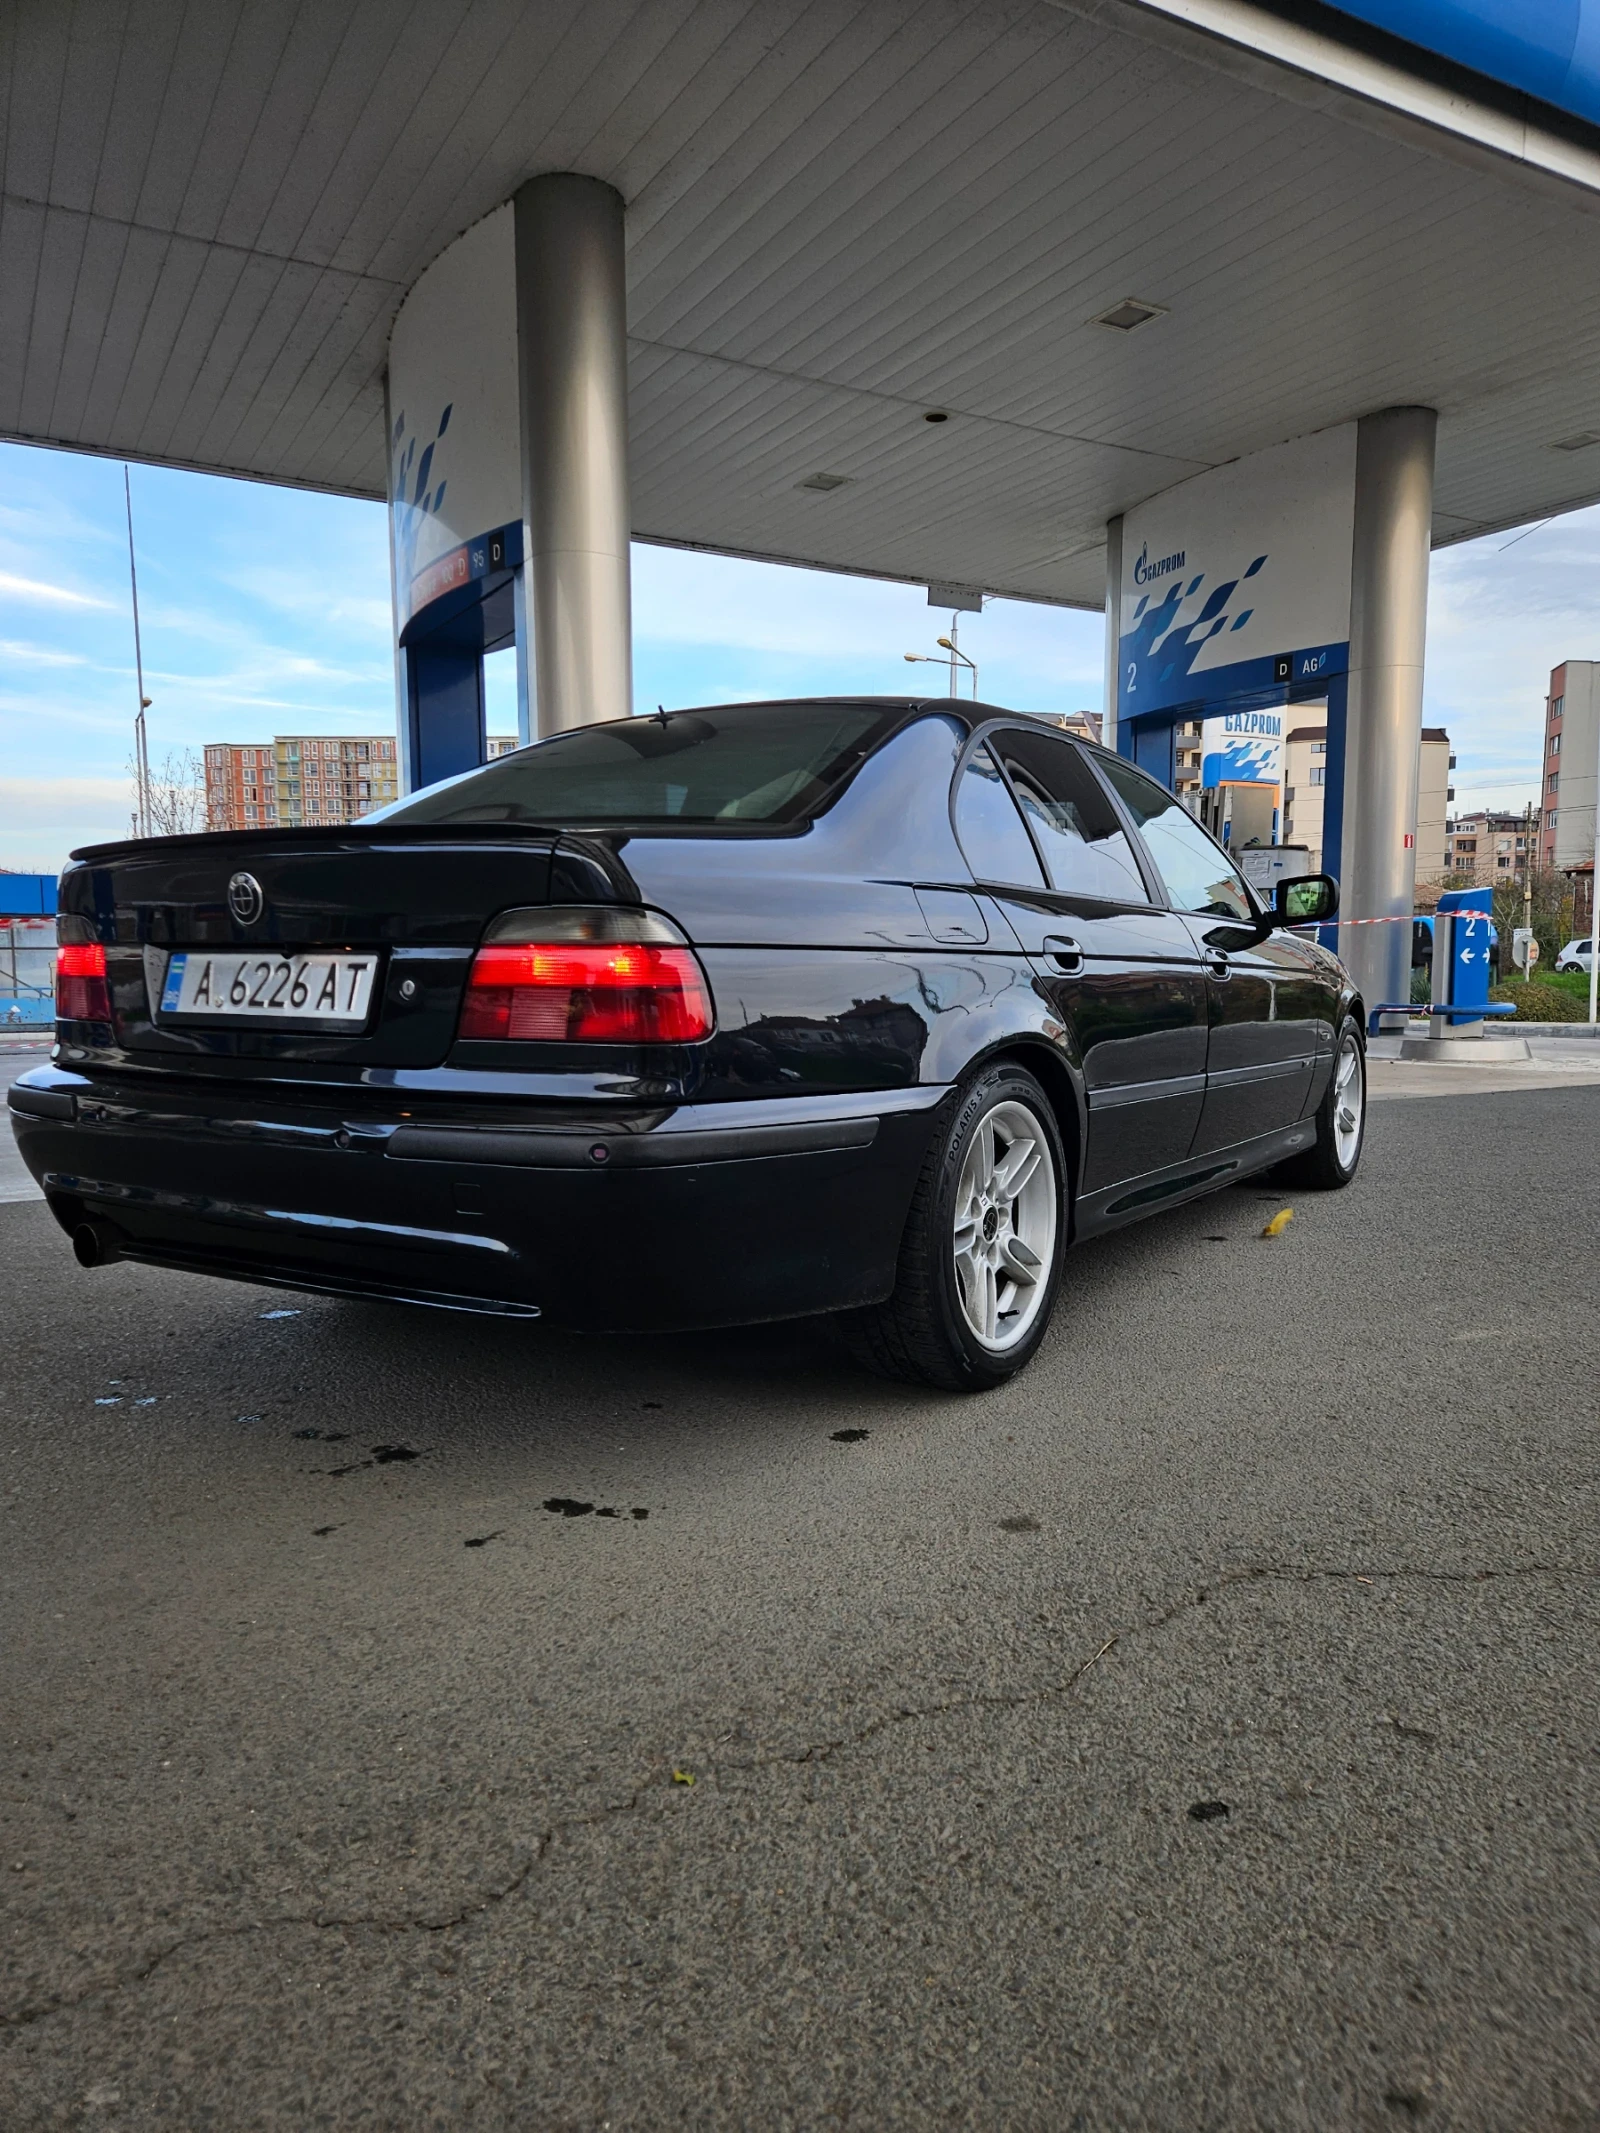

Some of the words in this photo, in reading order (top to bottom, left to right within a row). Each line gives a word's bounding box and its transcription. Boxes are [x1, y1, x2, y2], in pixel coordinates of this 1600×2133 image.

[459, 557, 466, 576] D
[473, 549, 484, 568] 95
[492, 543, 501, 561] D
[1147, 550, 1186, 582] GAZPROM
[1127, 662, 1137, 693] 2
[1279, 663, 1288, 676] D
[1302, 657, 1318, 674] AG
[1225, 712, 1281, 737] GAZPROM
[1465, 918, 1475, 936] 2
[948, 1099, 978, 1163] POLARIS
[976, 1090, 984, 1101] S
